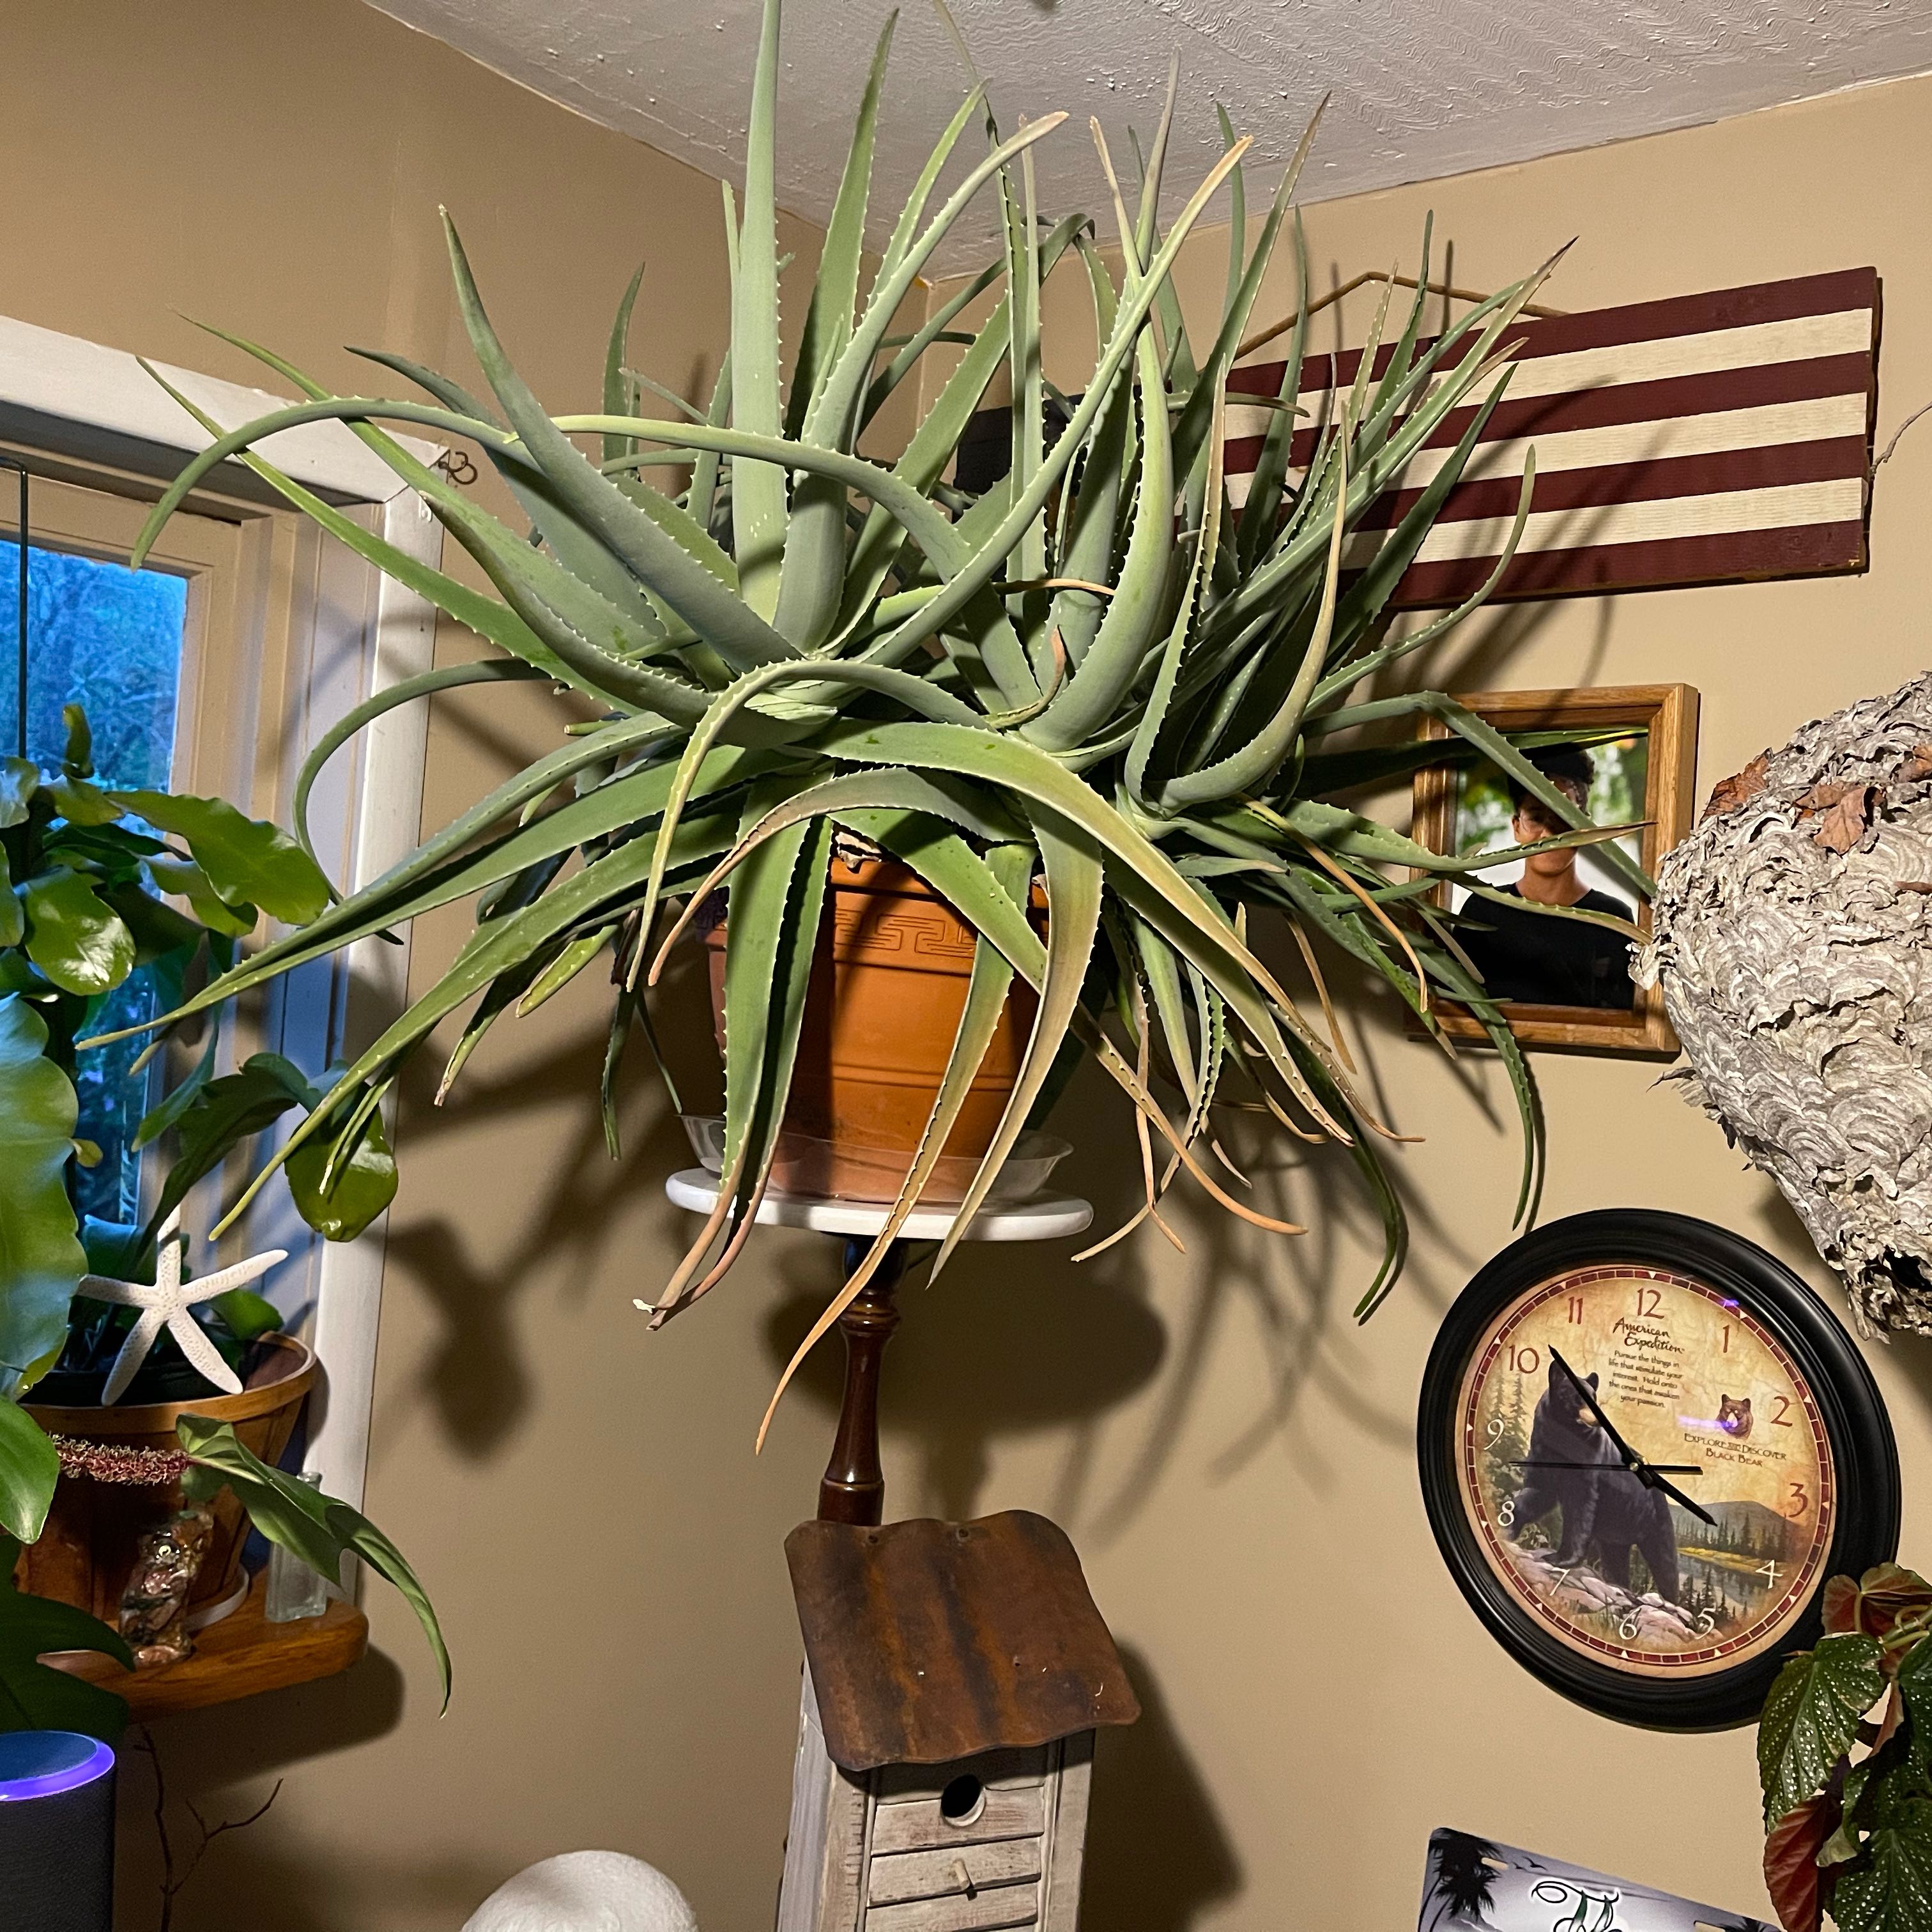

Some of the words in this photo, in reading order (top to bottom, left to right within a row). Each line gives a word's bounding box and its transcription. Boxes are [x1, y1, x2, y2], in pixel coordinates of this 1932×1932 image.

[1568, 1296, 1583, 1325] 11
[1636, 1287, 1665, 1320] 12
[1612, 1316, 1671, 1339] American
[1722, 1324, 1730, 1353] 1
[1508, 1344, 1540, 1374] 10
[1638, 1353, 1650, 1362] the
[1770, 1395, 1793, 1427] 2
[1483, 1418, 1504, 1450] 9
[1684, 1432, 1727, 1448] EXPLORE
[1742, 1445, 1787, 1460] DISCOVER
[1706, 1447, 1735, 1462] BLACK
[1738, 1453, 1763, 1468] BEAR
[1498, 1501, 1515, 1526] 8
[1788, 1483, 1809, 1518] 3
[1549, 1567, 1570, 1596] 7
[1755, 1560, 1783, 1589] 4
[1619, 1607, 1642, 1639] 6
[1695, 1605, 1719, 1640] 5
